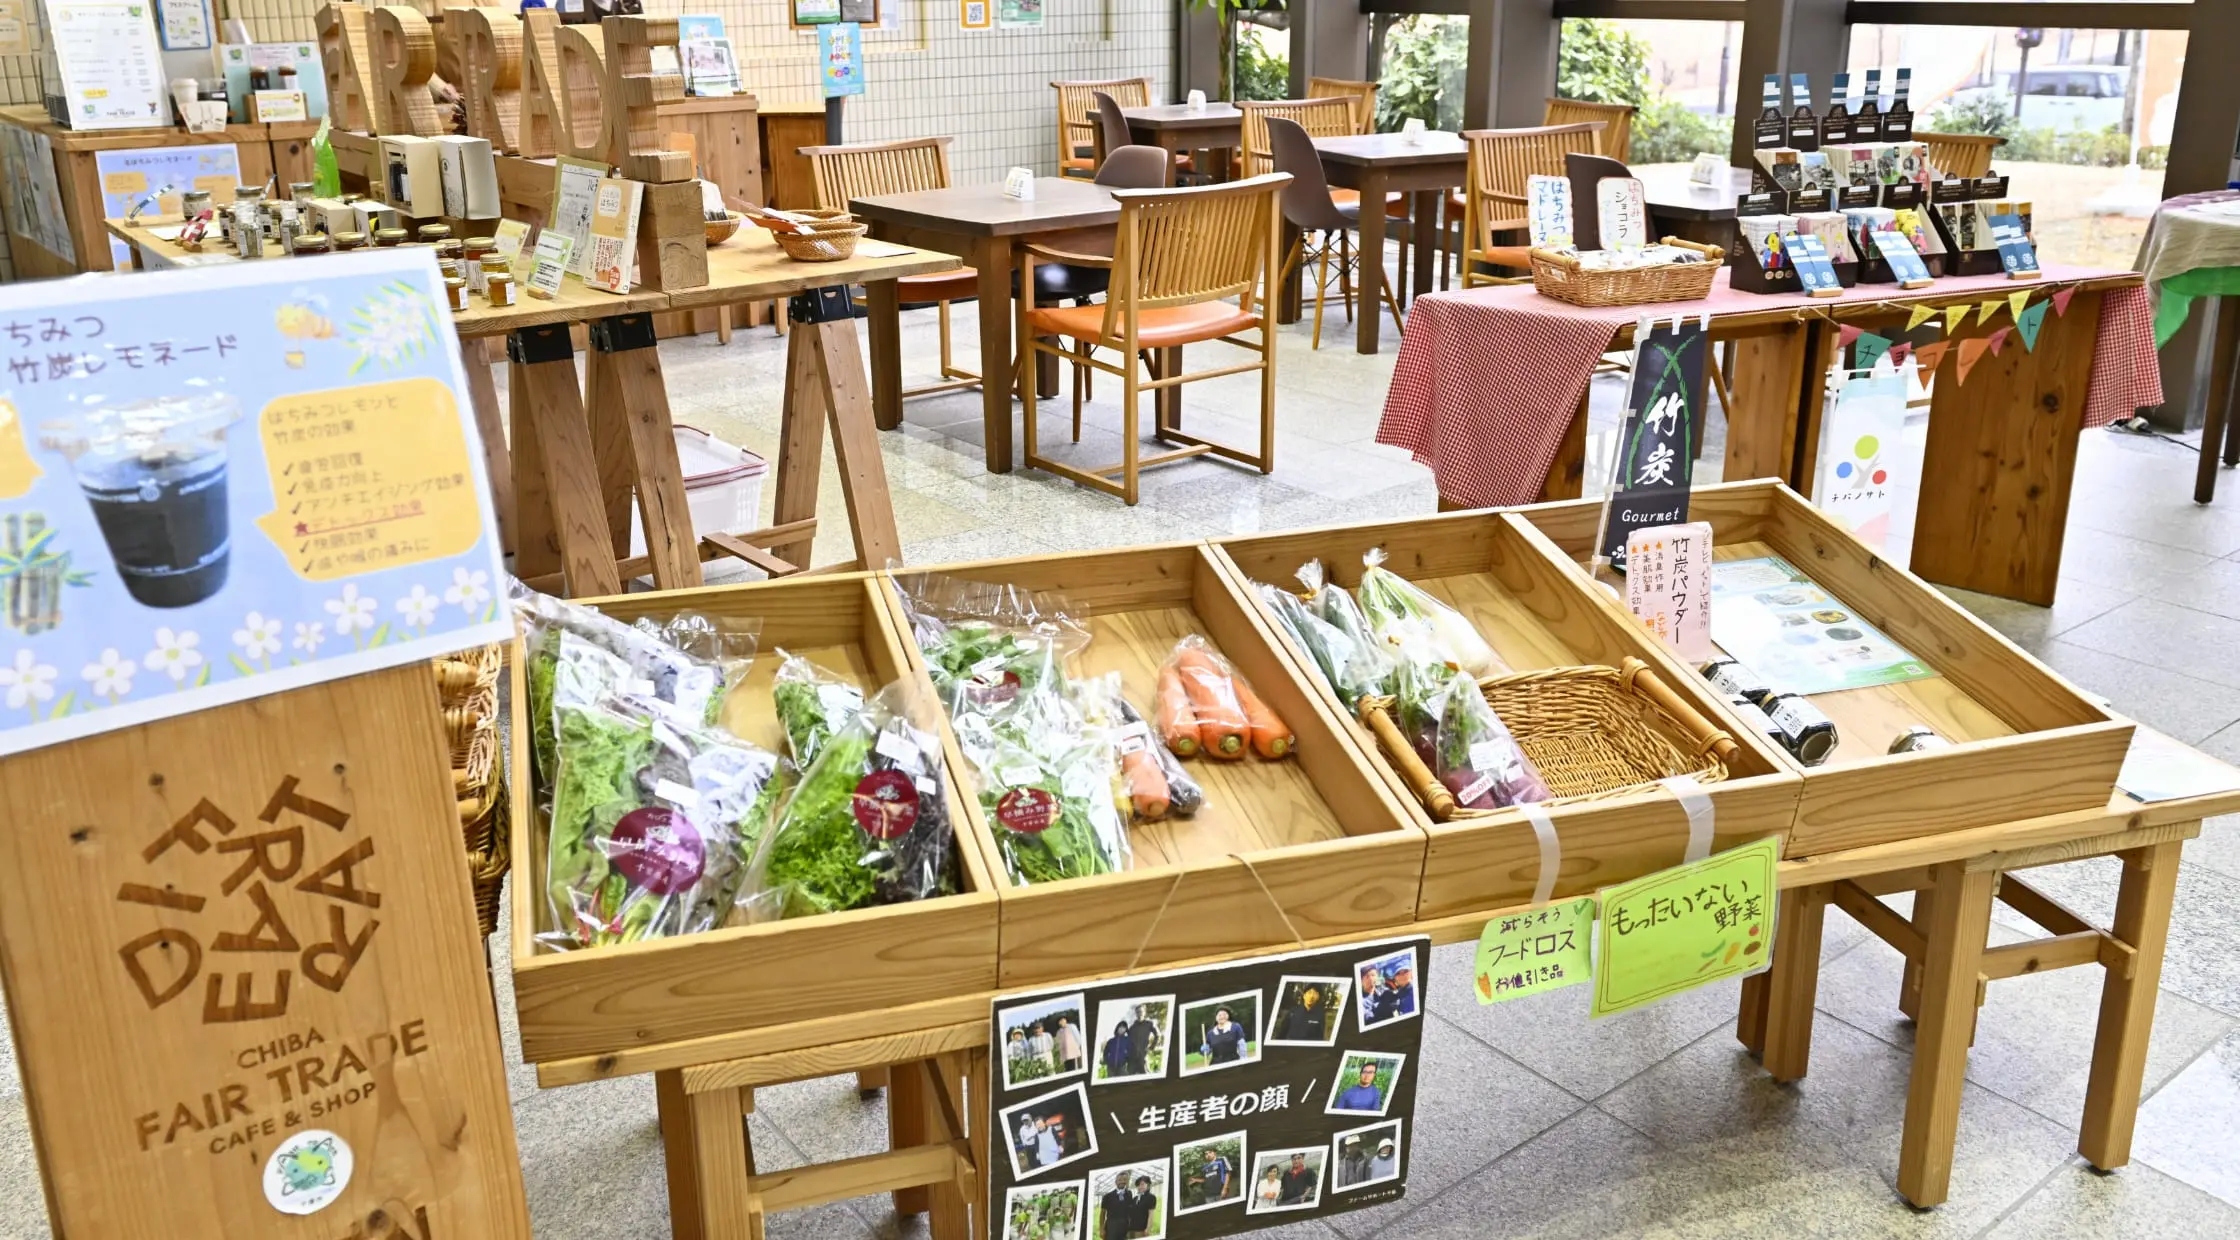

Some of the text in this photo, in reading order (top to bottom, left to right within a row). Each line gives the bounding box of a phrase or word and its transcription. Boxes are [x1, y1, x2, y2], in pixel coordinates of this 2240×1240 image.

[1615, 191, 1628, 238] ショコラ
[1634, 391, 1685, 486] 竹炭
[1621, 507, 1680, 523] Gourmet
[1671, 537, 1691, 645] 竹炭パウダー
[1611, 879, 1749, 937] もったいない
[1714, 895, 1763, 934] 野菜
[1488, 930, 1576, 967] フードロス
[1495, 963, 1564, 991] お値引き品
[237, 1027, 325, 1069] CHIBA
[134, 1018, 430, 1151] FAIR TRADE
[1138, 1083, 1290, 1134] 生産者の顔
[209, 1081, 377, 1155] CAFE & SHOP
